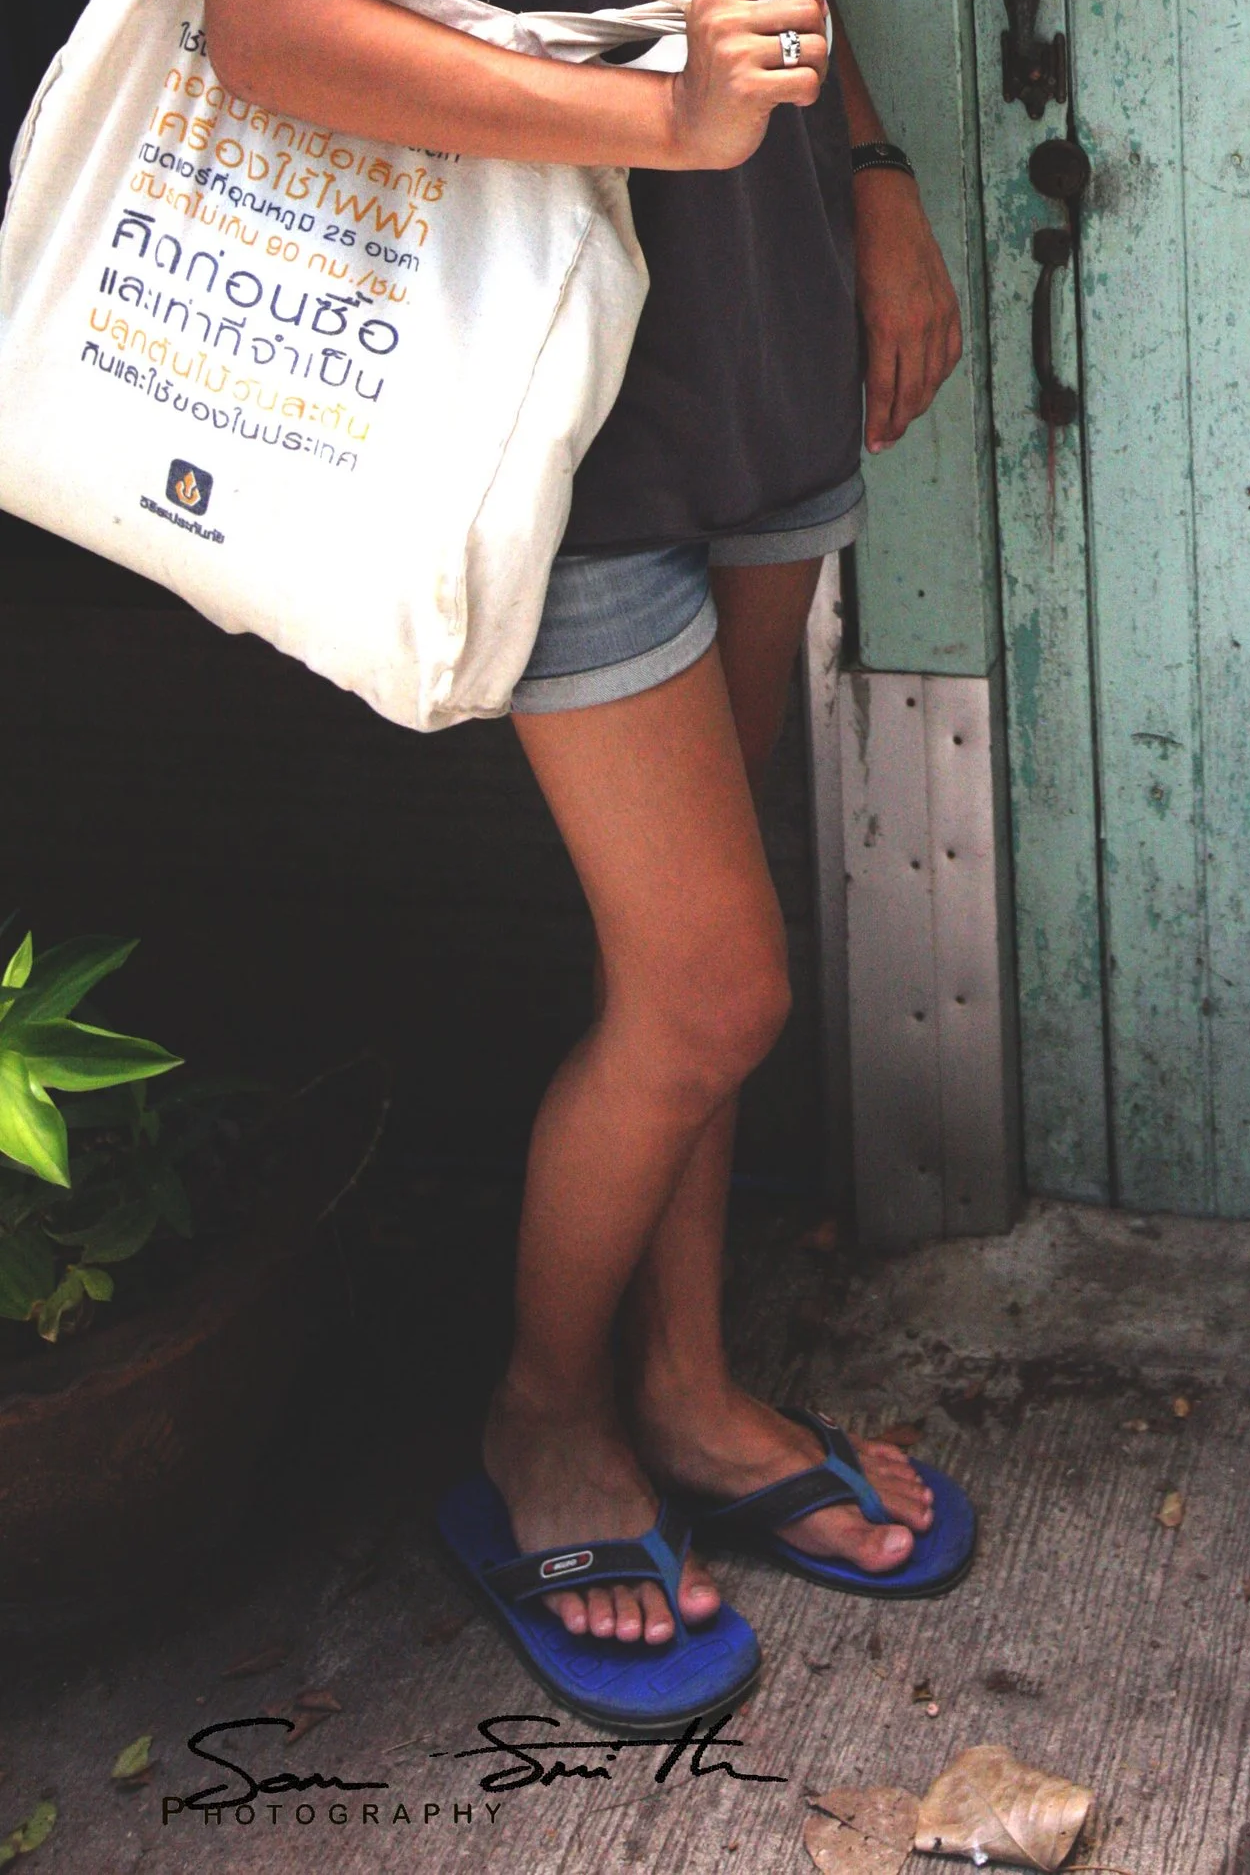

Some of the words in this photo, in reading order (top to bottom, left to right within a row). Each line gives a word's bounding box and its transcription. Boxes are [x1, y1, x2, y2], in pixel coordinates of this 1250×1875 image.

[149, 105, 431, 248] เครื่องใช้ไฟฟ้า
[111, 208, 400, 356] คิดก่อนซื้อ
[265, 234, 301, 263] 90
[322, 223, 357, 249] 25
[364, 240, 421, 274] องศา
